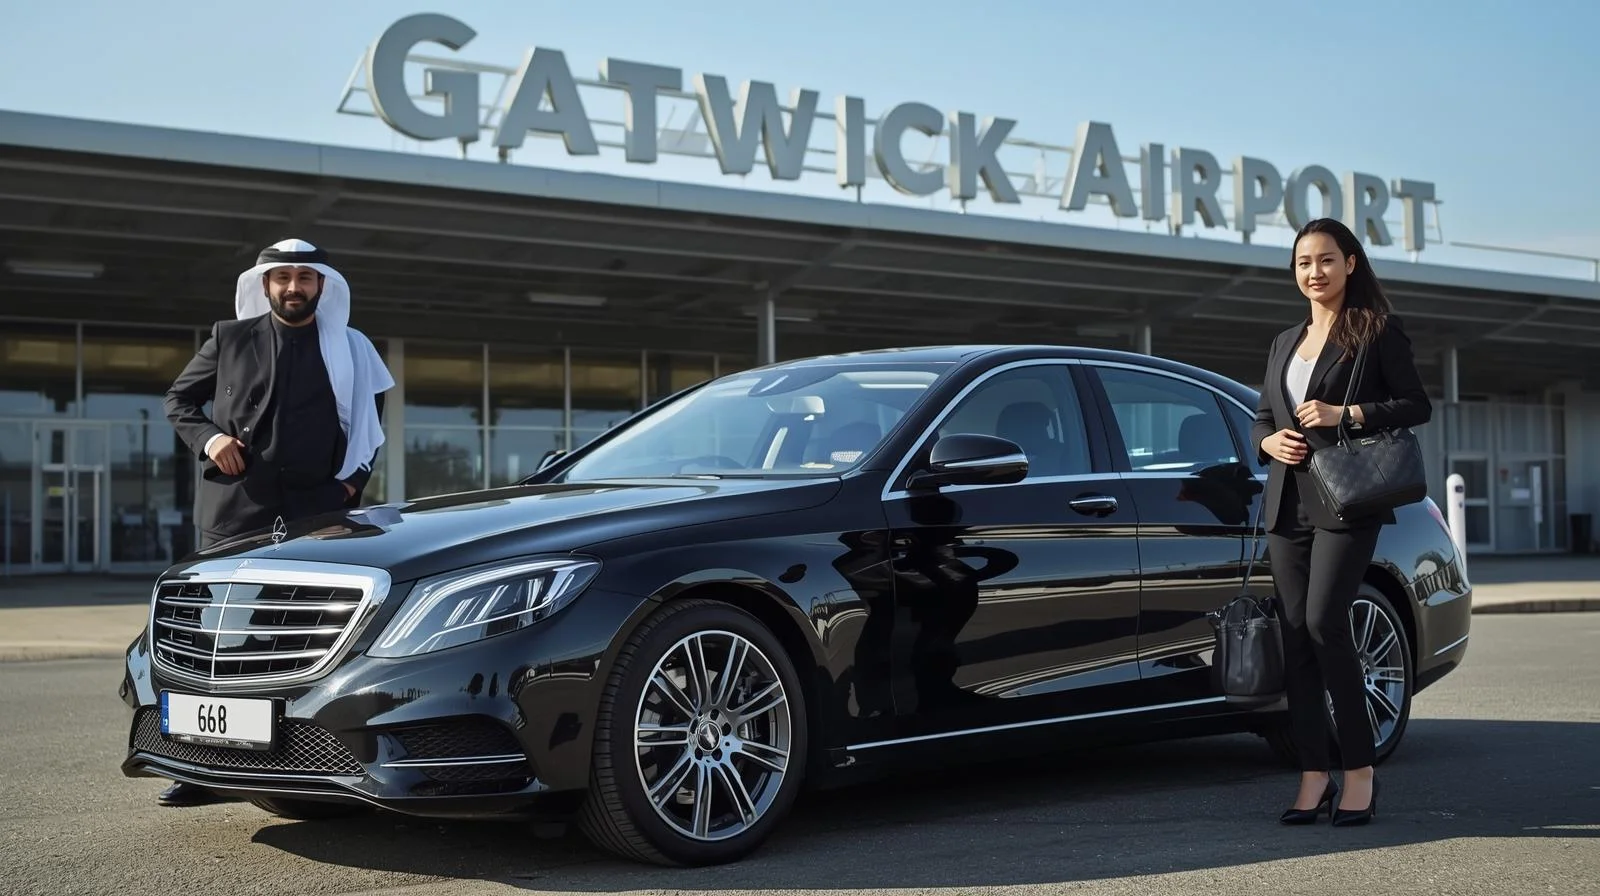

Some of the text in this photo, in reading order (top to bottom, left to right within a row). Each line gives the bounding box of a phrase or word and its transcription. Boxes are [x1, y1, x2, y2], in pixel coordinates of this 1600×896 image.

[366, 12, 1435, 252] GATWICK AIRPORT
[198, 704, 227, 734] 668
